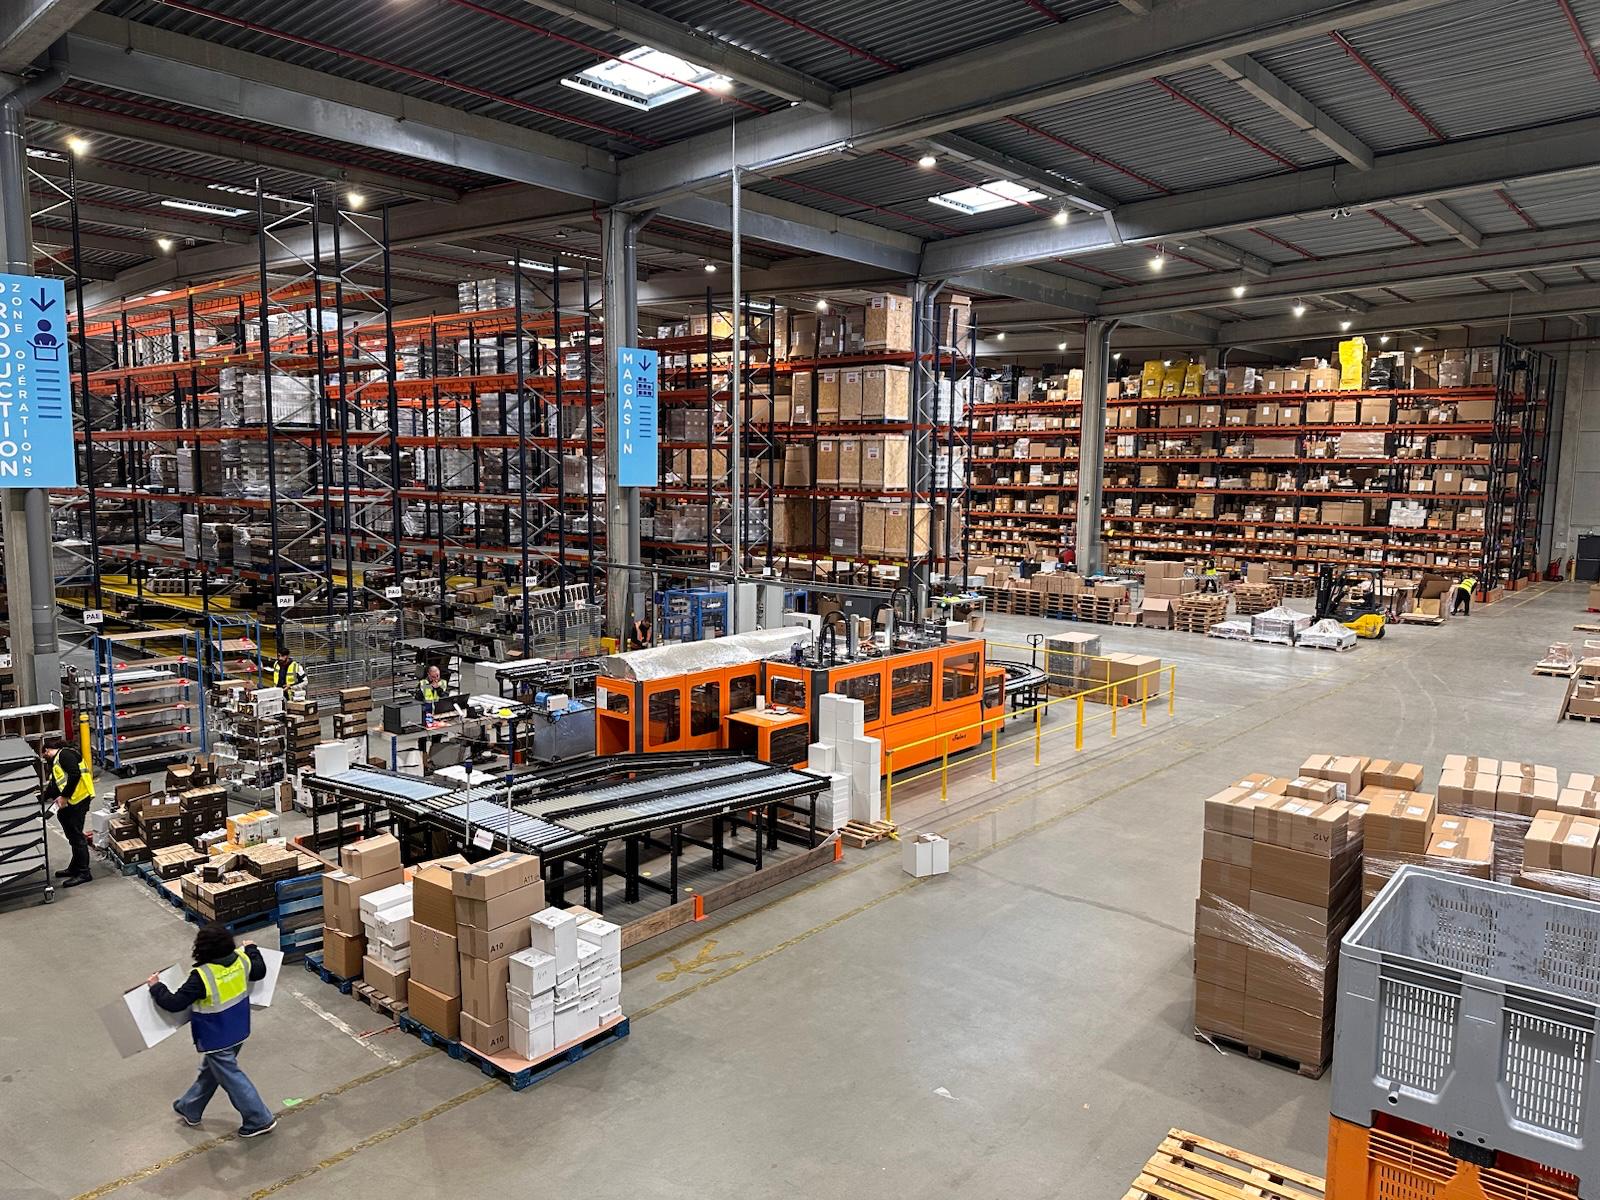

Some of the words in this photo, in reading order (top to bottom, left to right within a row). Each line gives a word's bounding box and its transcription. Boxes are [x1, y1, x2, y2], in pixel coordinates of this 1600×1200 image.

[12, 283, 23, 333] ZONE
[15, 350, 32, 477] OPÉRATIONS
[623, 353, 633, 455] MAGASIN
[1312, 832, 1329, 842] A12
[490, 942, 504, 953] A10
[490, 1035, 504, 1047] A10
